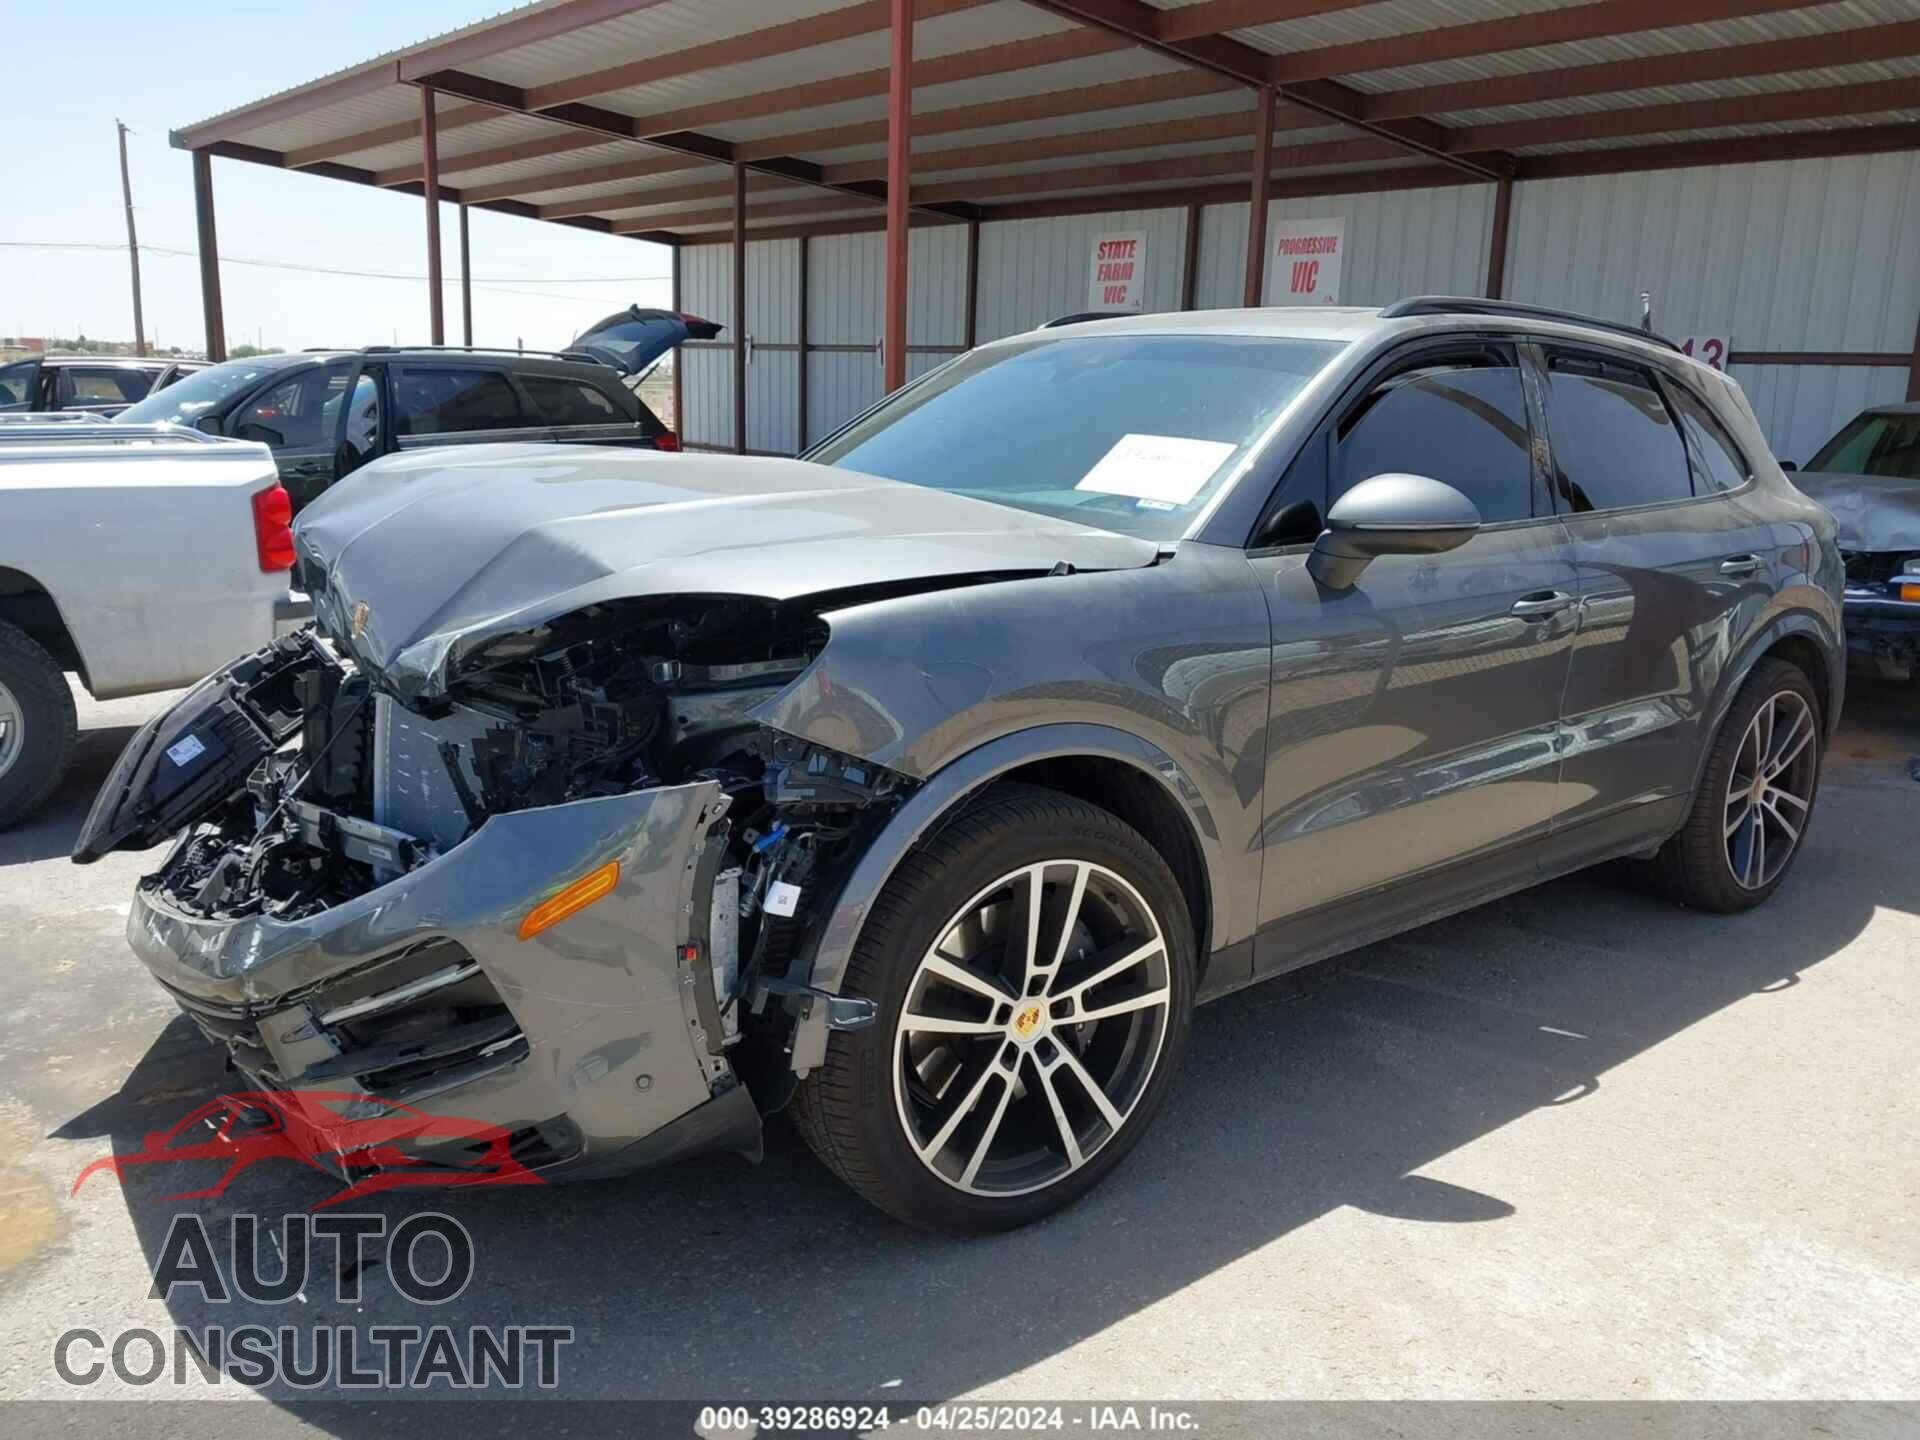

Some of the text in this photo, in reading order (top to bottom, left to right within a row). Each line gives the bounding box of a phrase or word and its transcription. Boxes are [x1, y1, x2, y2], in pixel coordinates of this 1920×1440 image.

[1096, 239, 1137, 260] STATE
[1277, 235, 1339, 256] PROGRESSIVE
[1096, 261, 1135, 282] FARM
[1290, 260, 1320, 294] VIC
[1103, 285, 1128, 305] VIC
